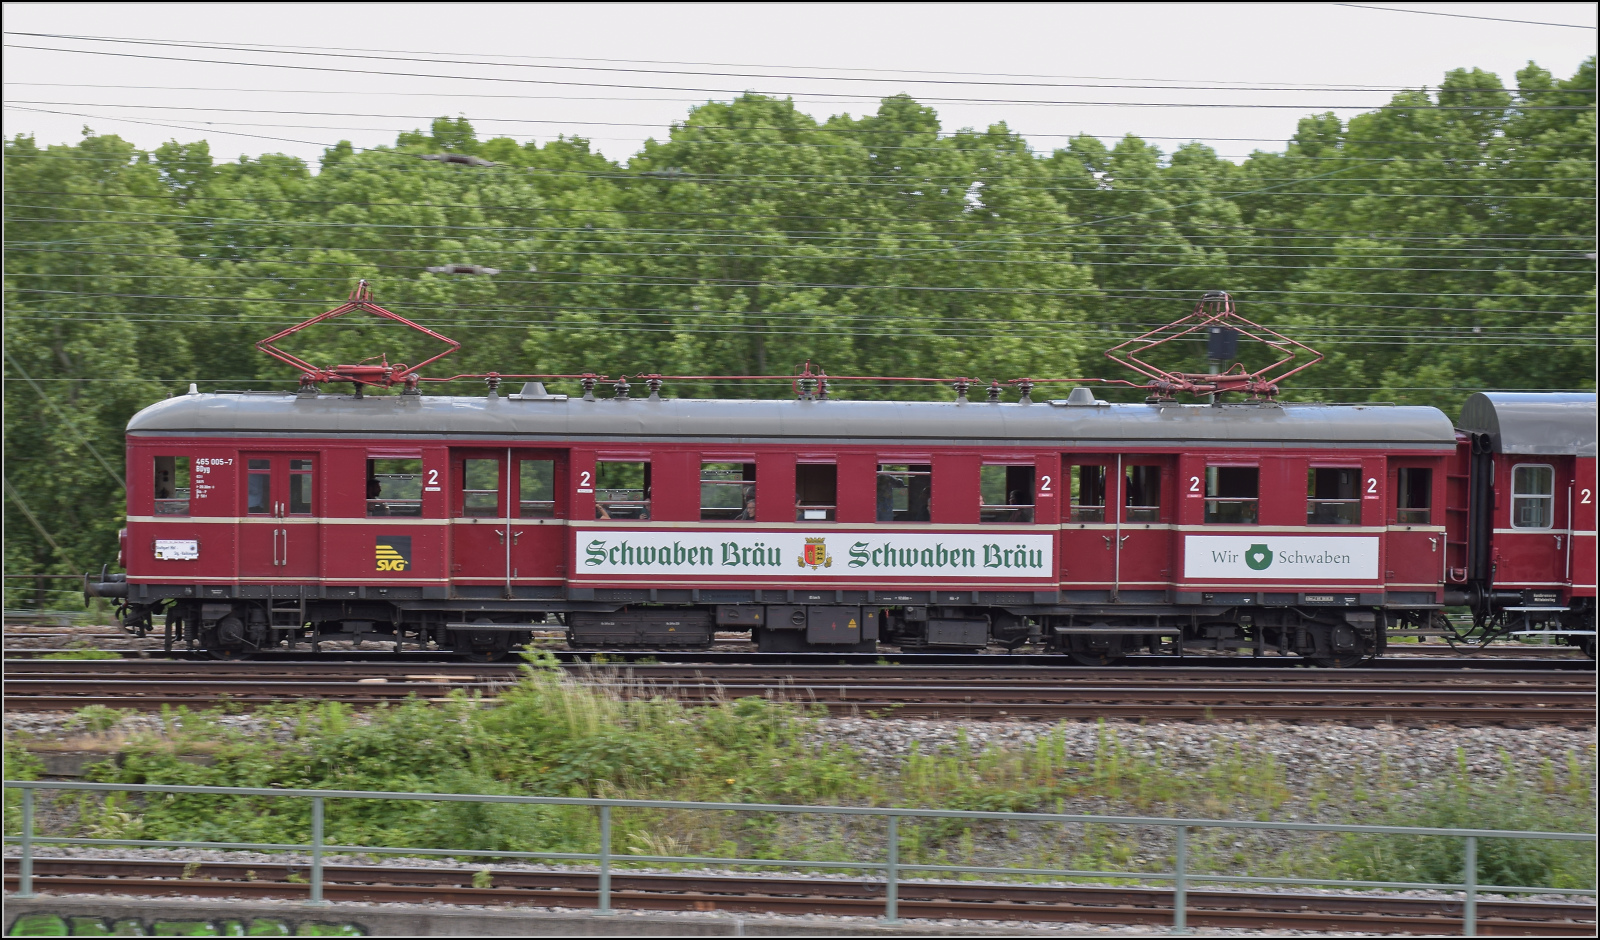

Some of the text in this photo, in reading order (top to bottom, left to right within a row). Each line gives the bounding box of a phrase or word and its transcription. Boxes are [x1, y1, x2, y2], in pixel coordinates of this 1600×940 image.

[428, 469, 439, 485] 2
[580, 471, 591, 487] 2
[1041, 475, 1051, 491] 2
[1189, 476, 1200, 492] 2
[1367, 477, 1377, 493] 2
[1580, 488, 1592, 504] 2
[584, 539, 782, 567] Schwaben Bräu
[847, 541, 1044, 569] Schwaben Bräu
[1211, 550, 1351, 564] Wir Schwaben
[376, 559, 405, 572] SVG
